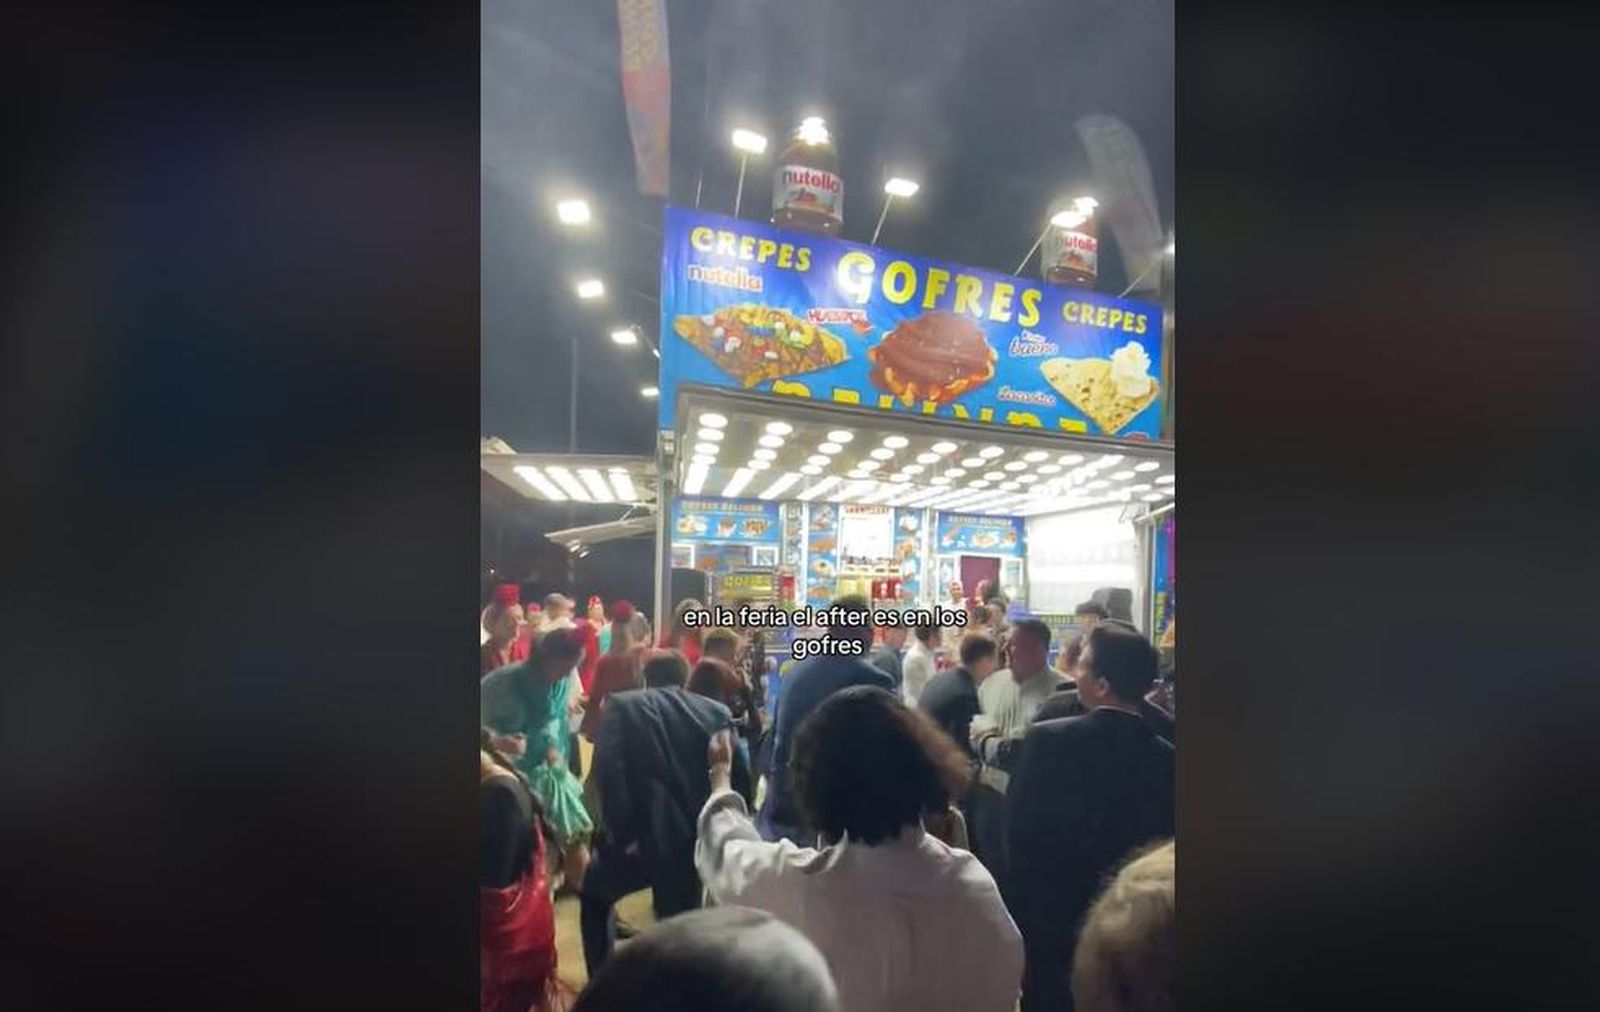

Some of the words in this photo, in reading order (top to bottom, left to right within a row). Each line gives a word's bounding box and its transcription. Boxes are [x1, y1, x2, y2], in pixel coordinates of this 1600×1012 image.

[782, 168, 840, 194] nutella
[690, 226, 812, 272] CREPES
[838, 251, 1043, 328] GOFRES
[1062, 301, 1148, 334] CREPES
